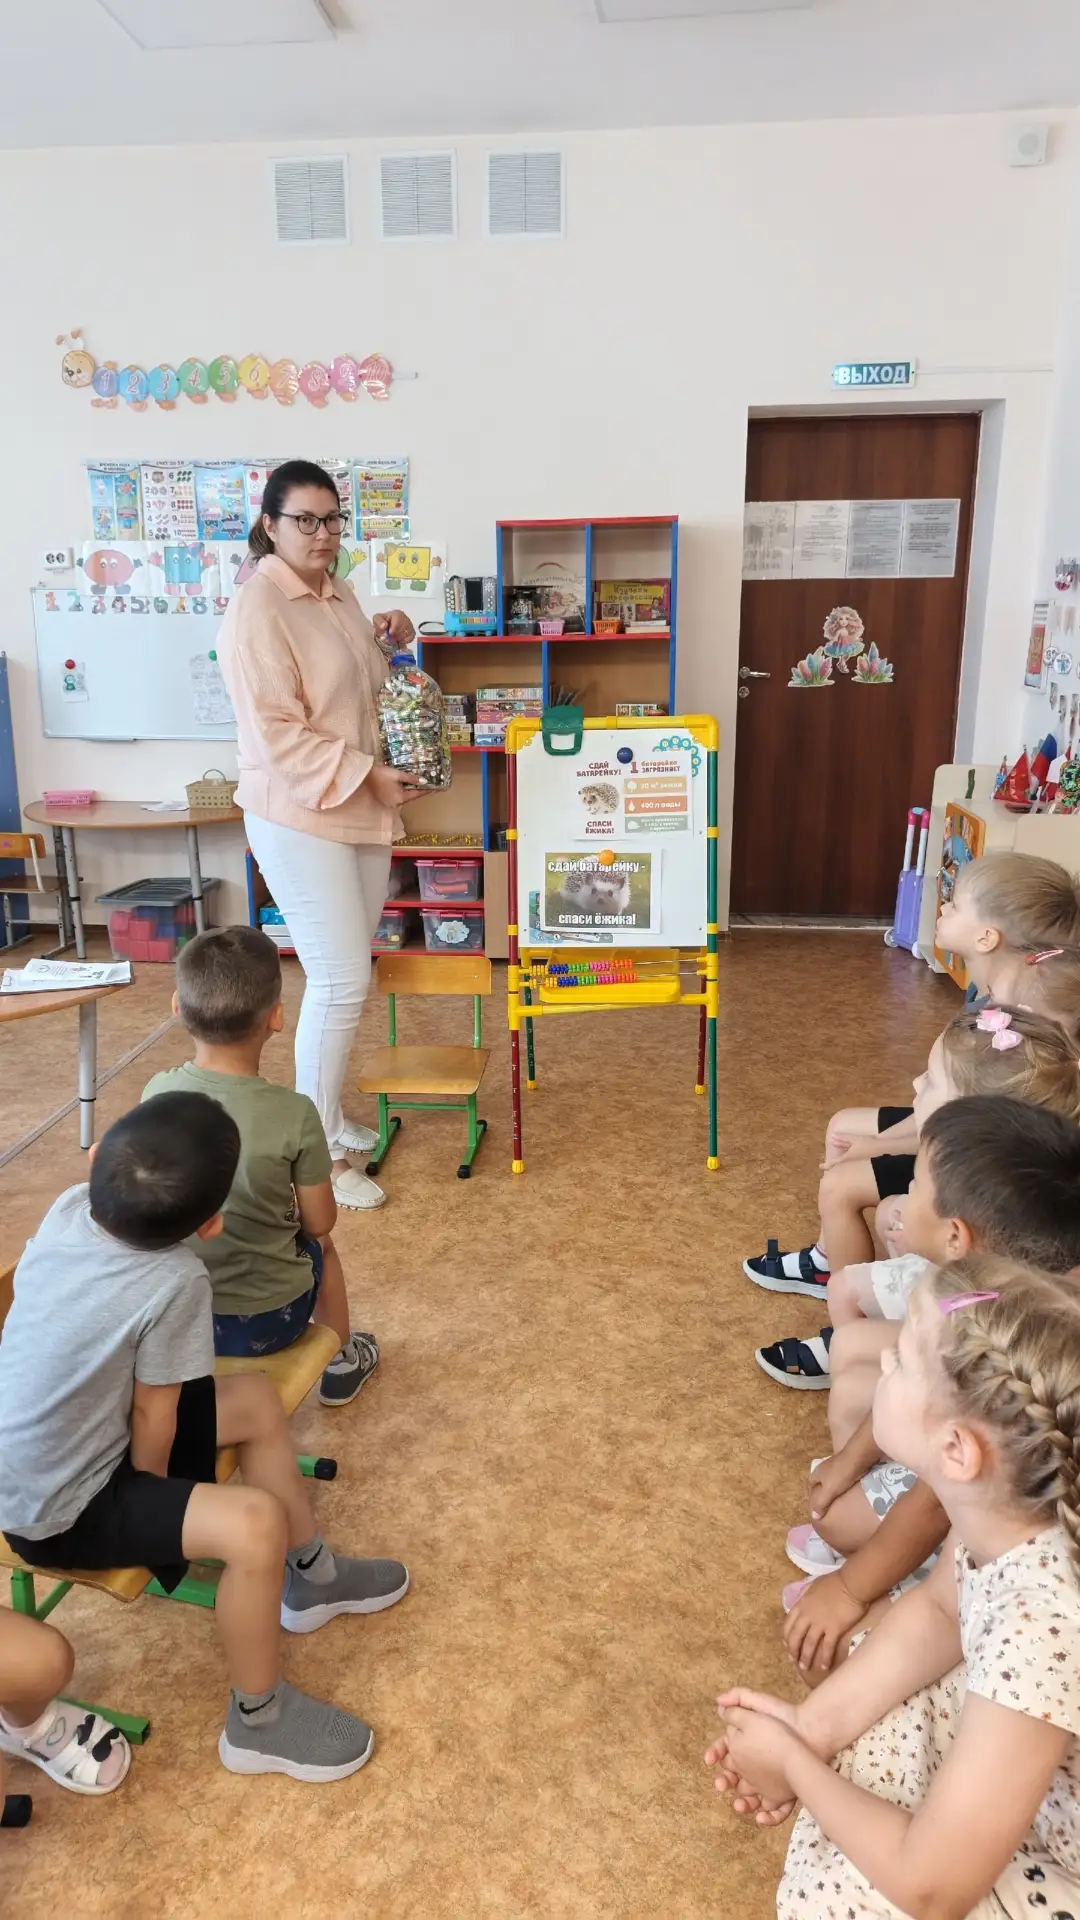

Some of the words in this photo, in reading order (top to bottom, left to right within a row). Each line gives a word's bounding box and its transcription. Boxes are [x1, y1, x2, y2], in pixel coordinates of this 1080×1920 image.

[102, 370, 110, 391] 1
[128, 375, 140, 394] 2
[158, 373, 170, 393] 3
[188, 367, 200, 388] 4
[217, 365, 231, 385] 5
[250, 362, 261, 382] 6
[277, 368, 291, 388] 7
[308, 370, 322, 391] 8
[838, 365, 907, 385] ВЫХОД
[588, 761, 609, 770] СДАЙ
[630, 761, 638, 774] 1
[576, 769, 621, 777] БАТАРЕЙКУ!
[548, 859, 577, 872] сдай
[580, 860, 639, 873] батарейку
[558, 914, 592, 924] спаси
[594, 913, 636, 925] ёжика!
